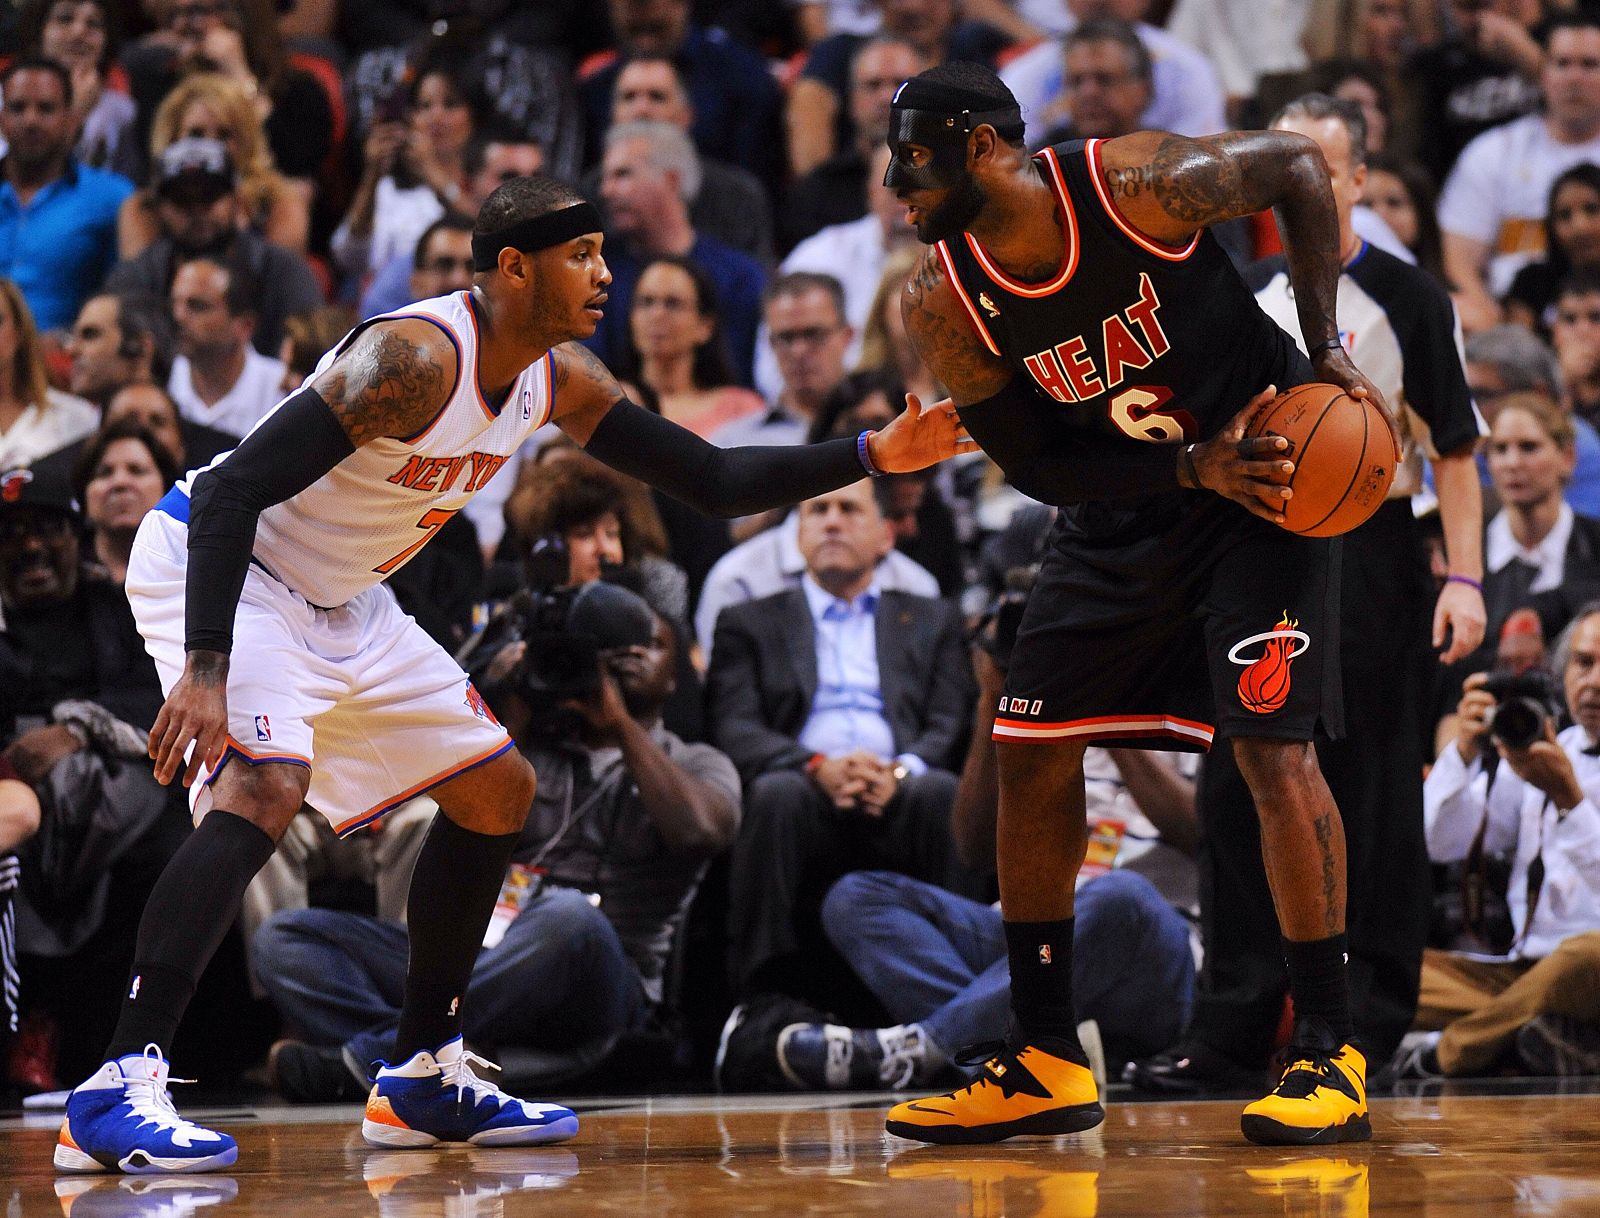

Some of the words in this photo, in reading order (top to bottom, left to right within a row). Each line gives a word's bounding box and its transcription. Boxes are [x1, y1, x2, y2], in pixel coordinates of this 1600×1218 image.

[1023, 272, 1171, 403] HEAT
[1108, 386, 1190, 444] 6
[386, 453, 472, 492] NEW
[371, 508, 459, 574] 7
